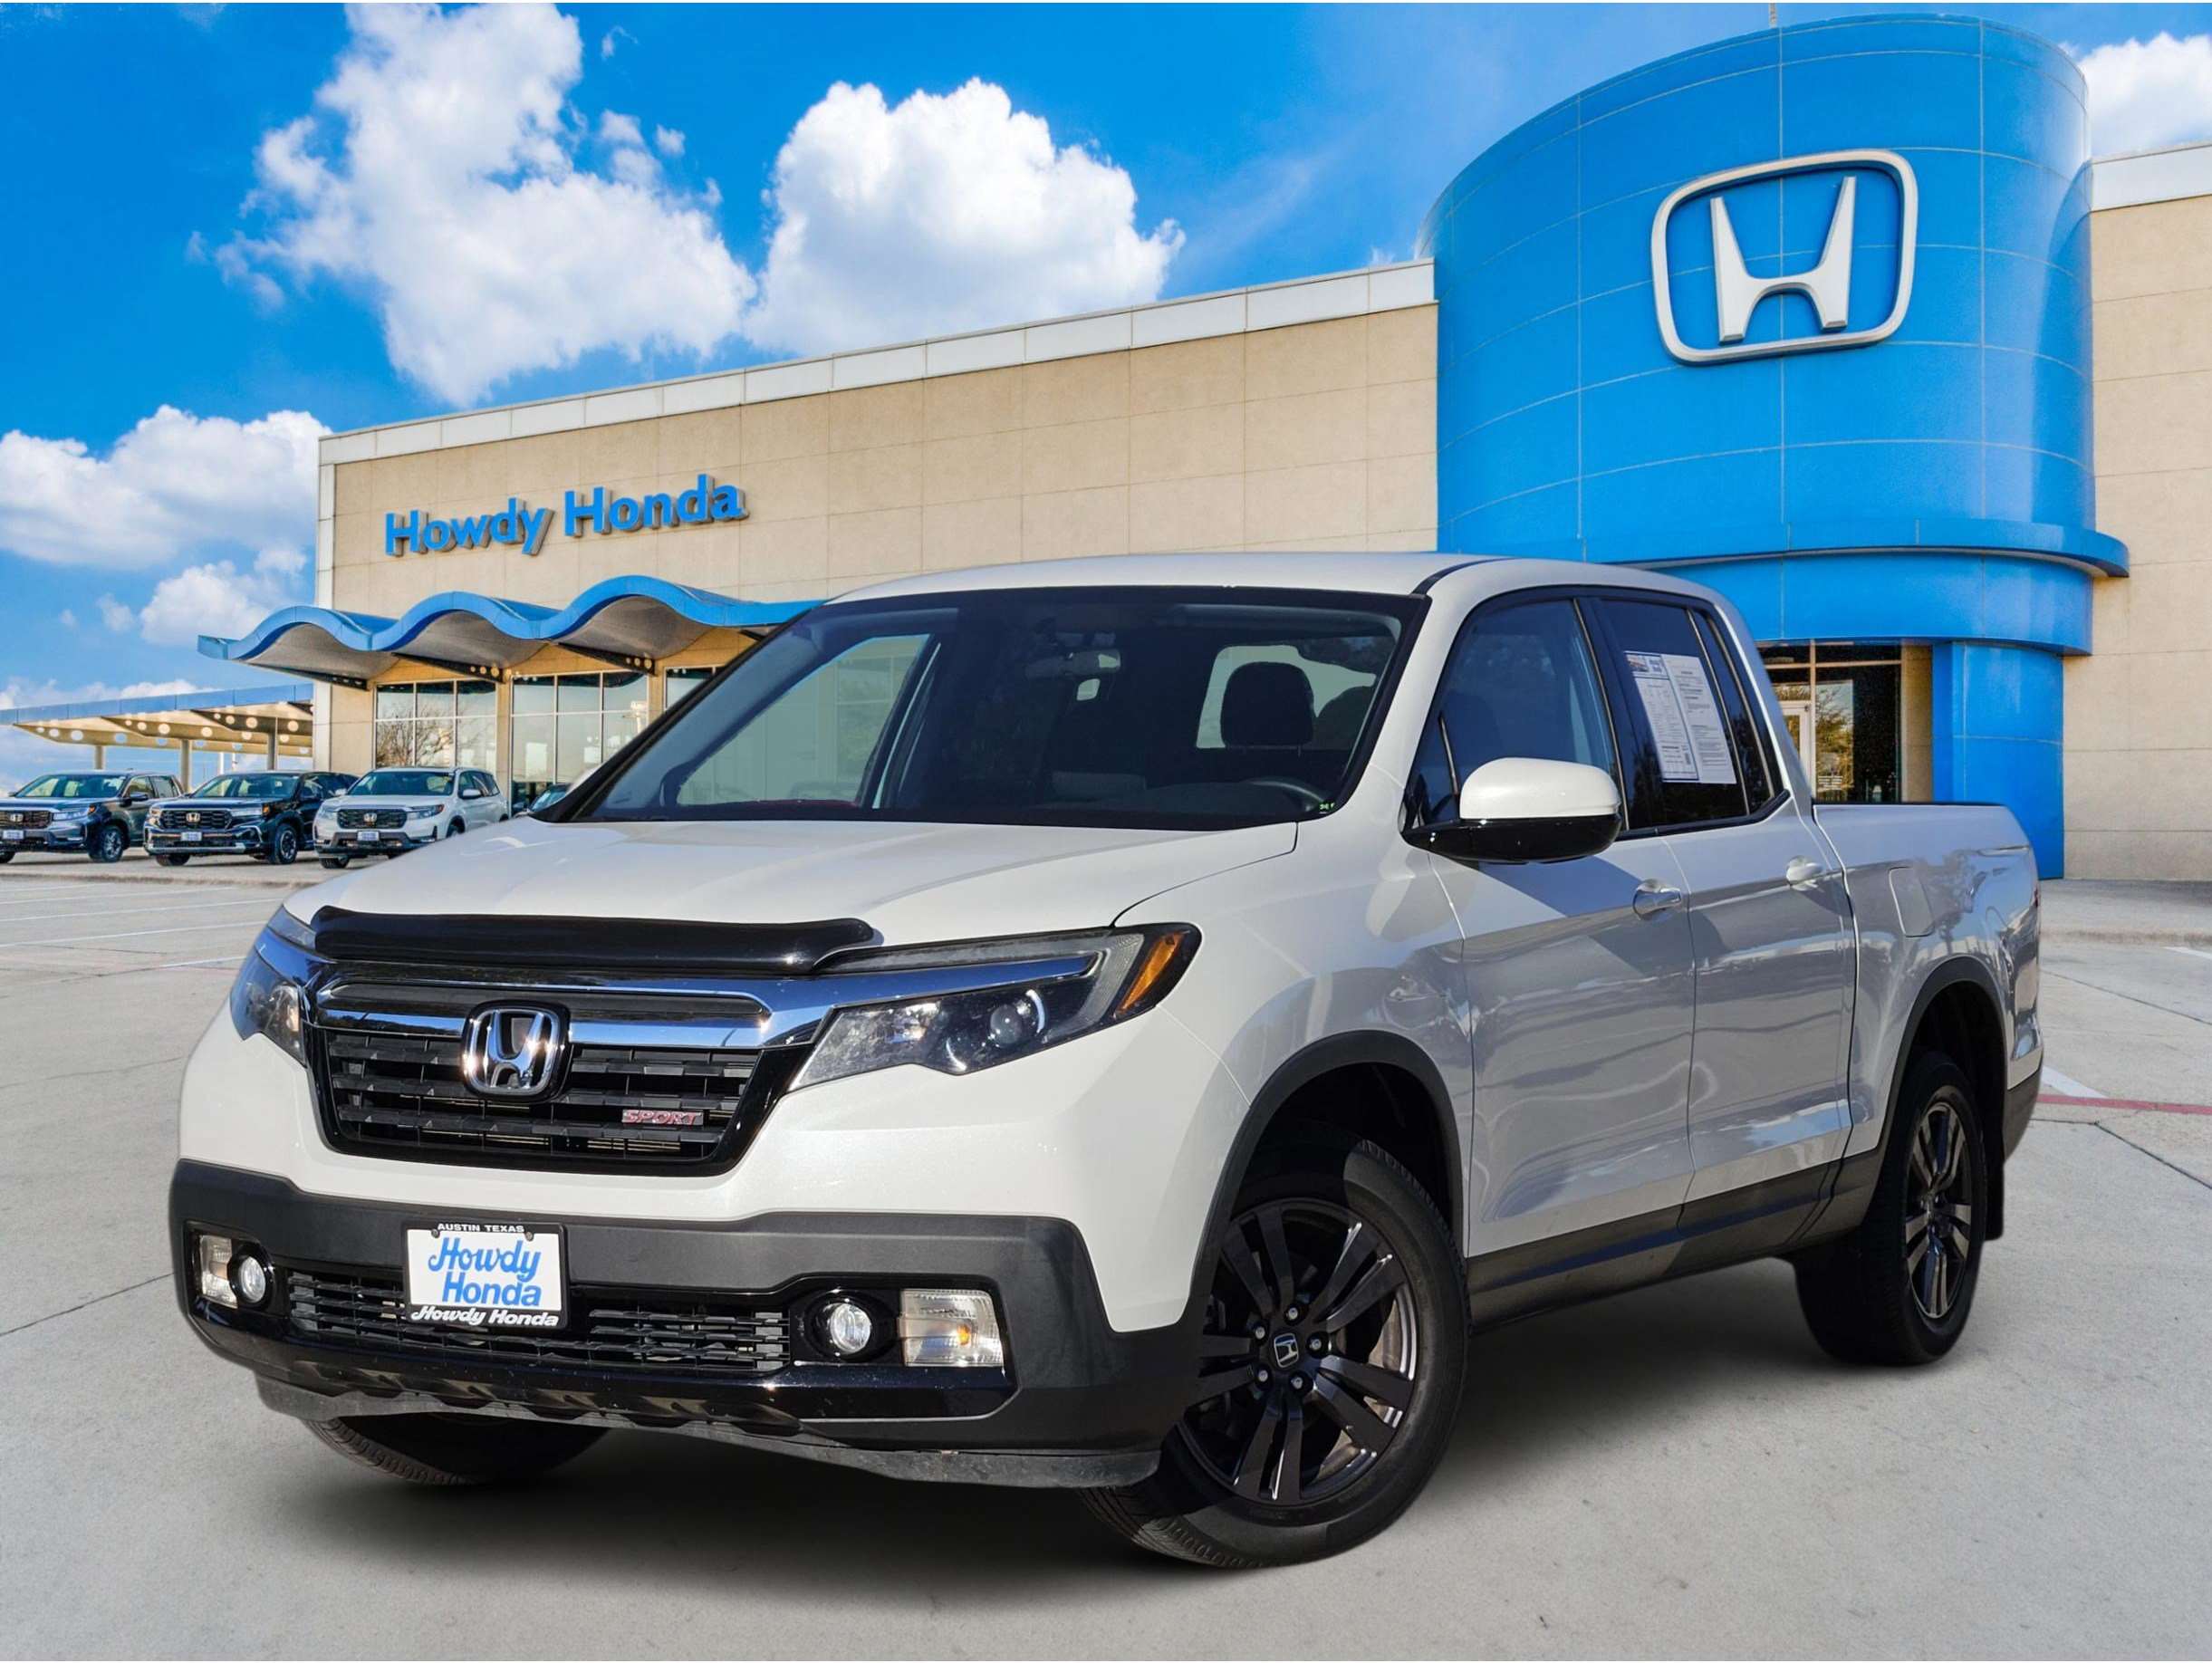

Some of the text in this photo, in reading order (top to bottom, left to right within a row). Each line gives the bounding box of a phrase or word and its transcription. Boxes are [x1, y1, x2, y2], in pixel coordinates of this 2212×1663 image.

[385, 473, 749, 557] Howdy Honda
[622, 1110, 703, 1126] SPORT
[438, 1223, 524, 1233] AUSTIN TEXAS
[428, 1237, 542, 1283] Howdy
[442, 1272, 542, 1306] Honda
[411, 1305, 560, 1327] Howdy Honda
